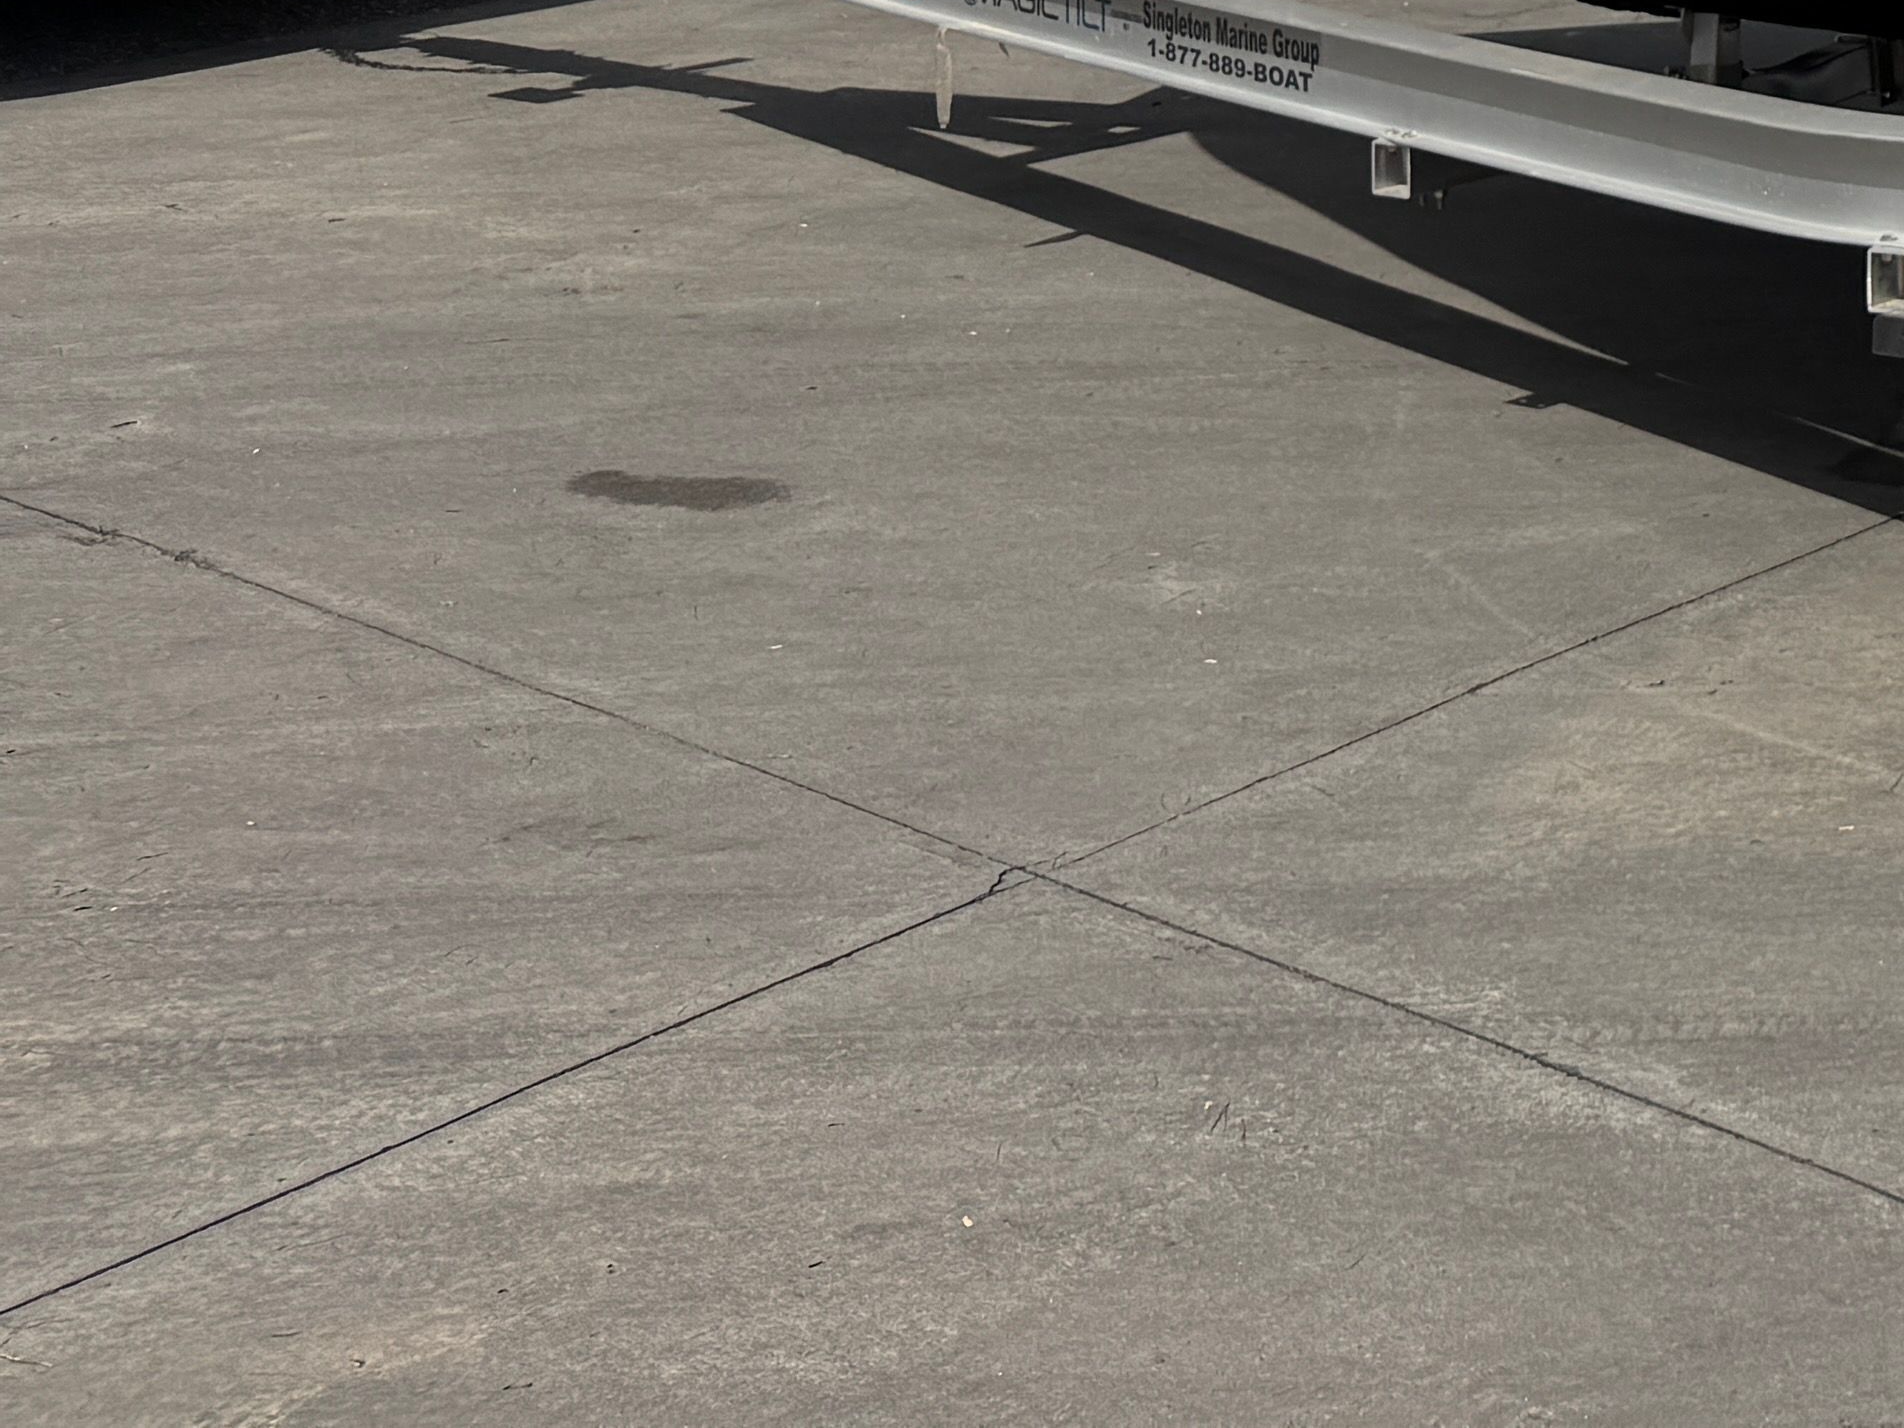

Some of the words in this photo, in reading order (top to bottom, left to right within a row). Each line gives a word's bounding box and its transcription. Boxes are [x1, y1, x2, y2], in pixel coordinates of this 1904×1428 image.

[1143, 0, 1211, 43] Singleton
[1216, 17, 1268, 55] Marine
[1272, 28, 1320, 72] Group
[1147, 38, 1313, 93] 1-877-889-BOAT
